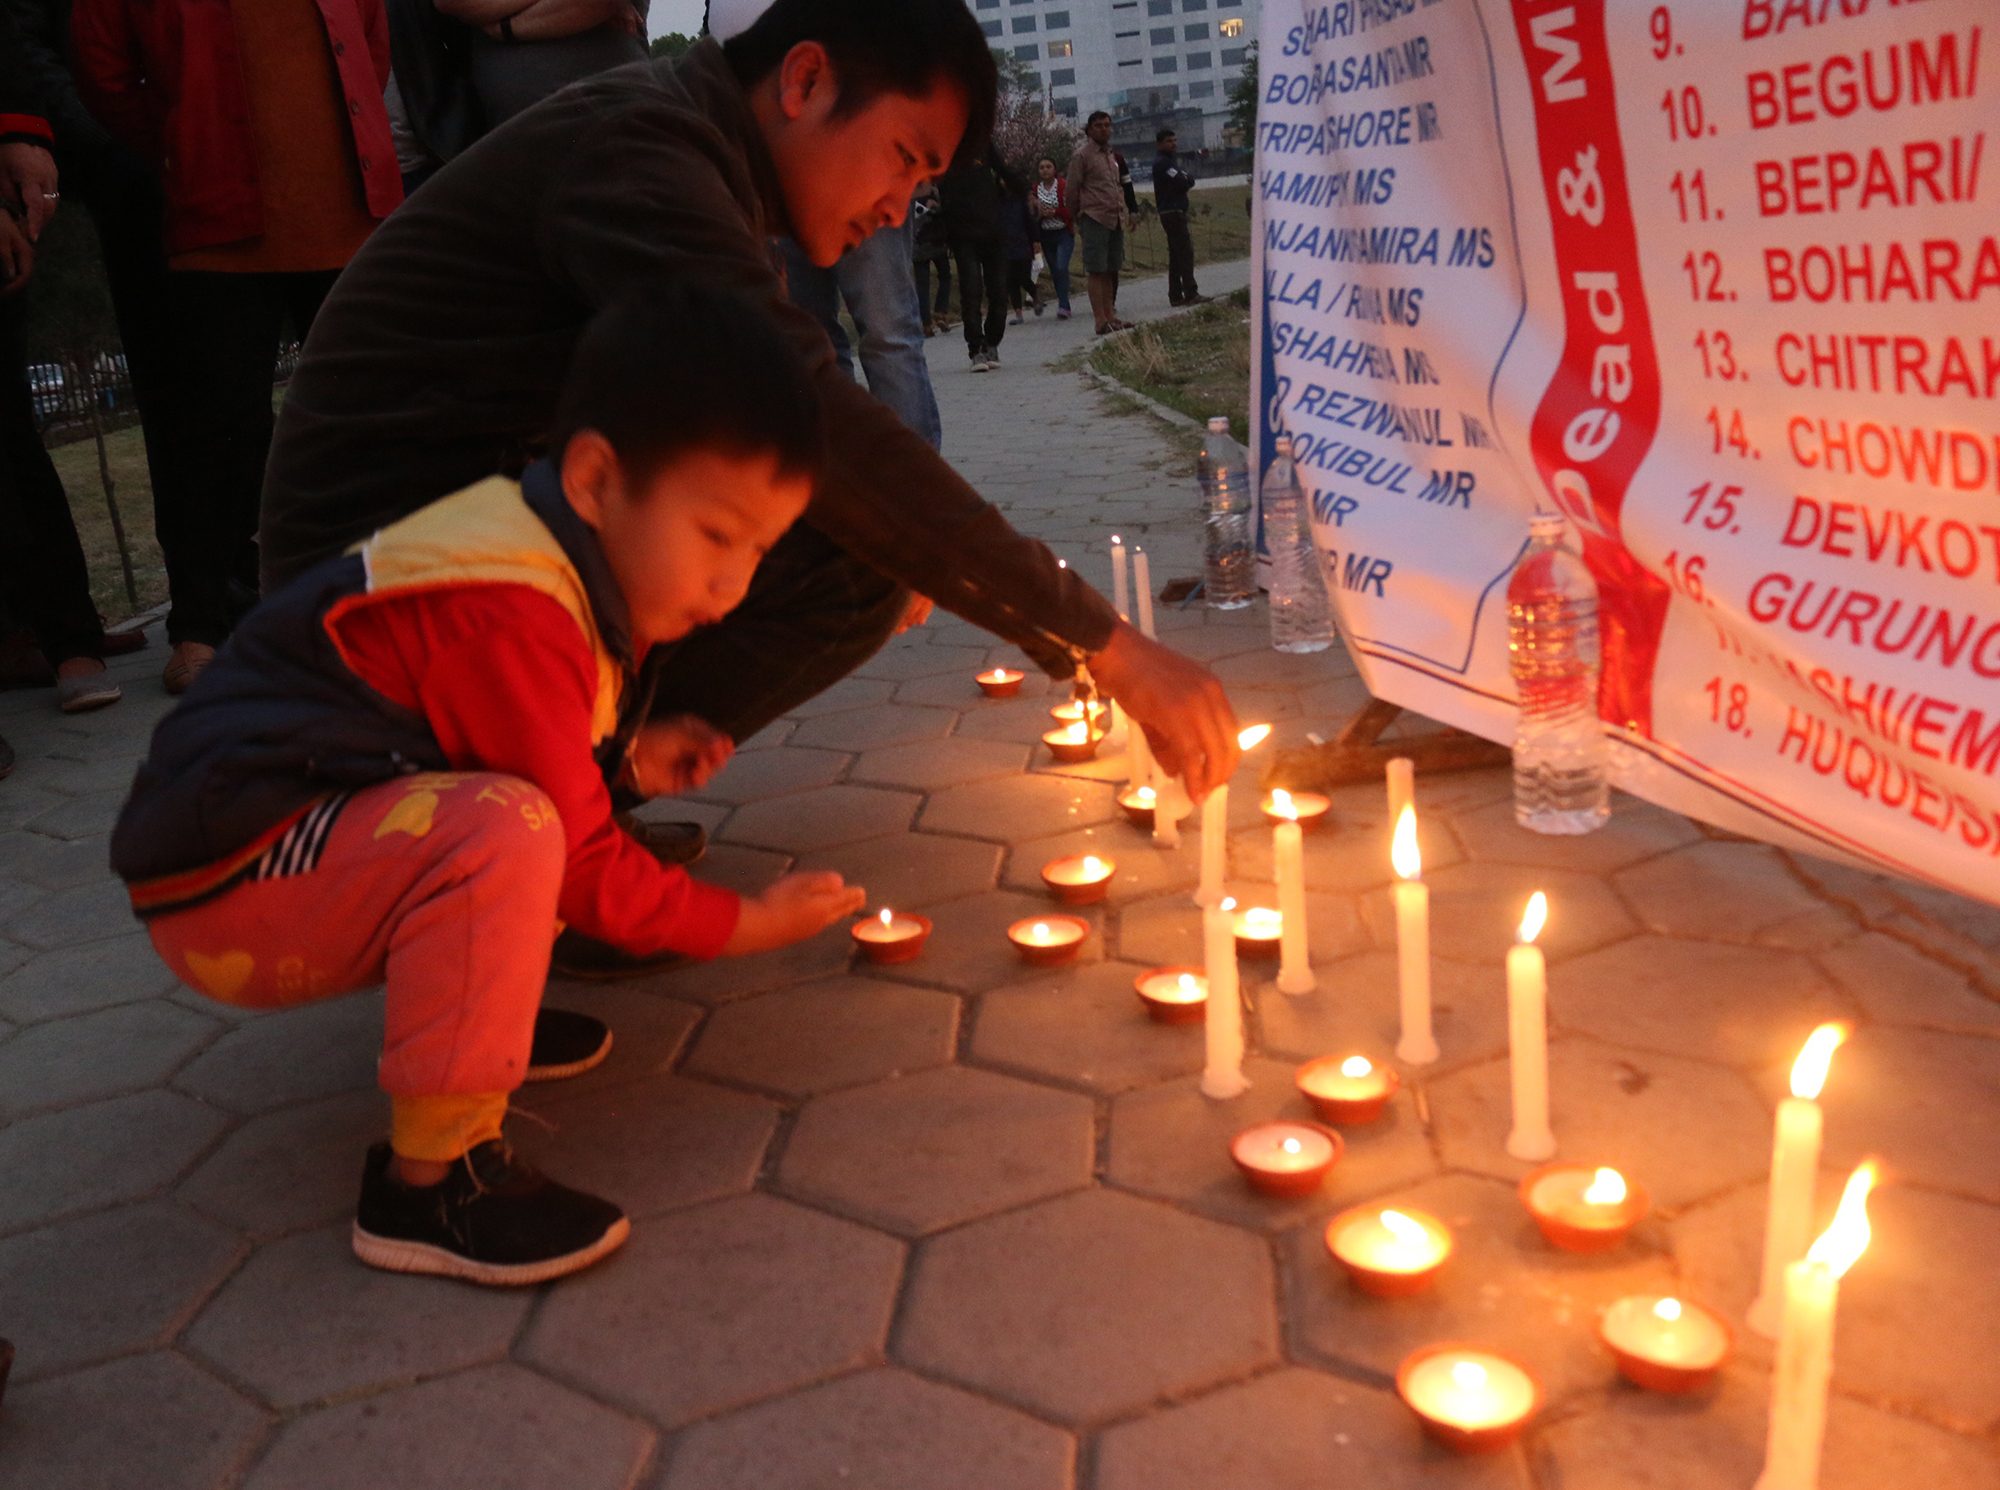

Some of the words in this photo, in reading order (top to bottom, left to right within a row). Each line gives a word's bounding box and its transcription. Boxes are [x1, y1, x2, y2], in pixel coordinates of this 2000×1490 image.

[1650, 5, 1684, 60] 9.
[1661, 85, 1717, 142] 10.
[1746, 25, 1982, 129] BEGUM/
[1353, 168, 1396, 205] MS
[1557, 143, 1606, 228] &
[1670, 169, 1725, 223] 11.
[1755, 132, 1986, 217] BEPARI/
[1447, 227, 1495, 268] MS
[1683, 251, 1738, 302] 12.
[1763, 235, 2000, 303] BOHARA
[1694, 329, 1749, 382] 13.
[1706, 405, 1761, 461] 14.
[1787, 415, 2000, 495] CHOWD
[1311, 488, 1360, 528] MR
[1417, 469, 1476, 509] MR
[1683, 481, 1742, 535] 15.
[1341, 552, 1393, 599] MR
[1704, 675, 1752, 739] 18.
